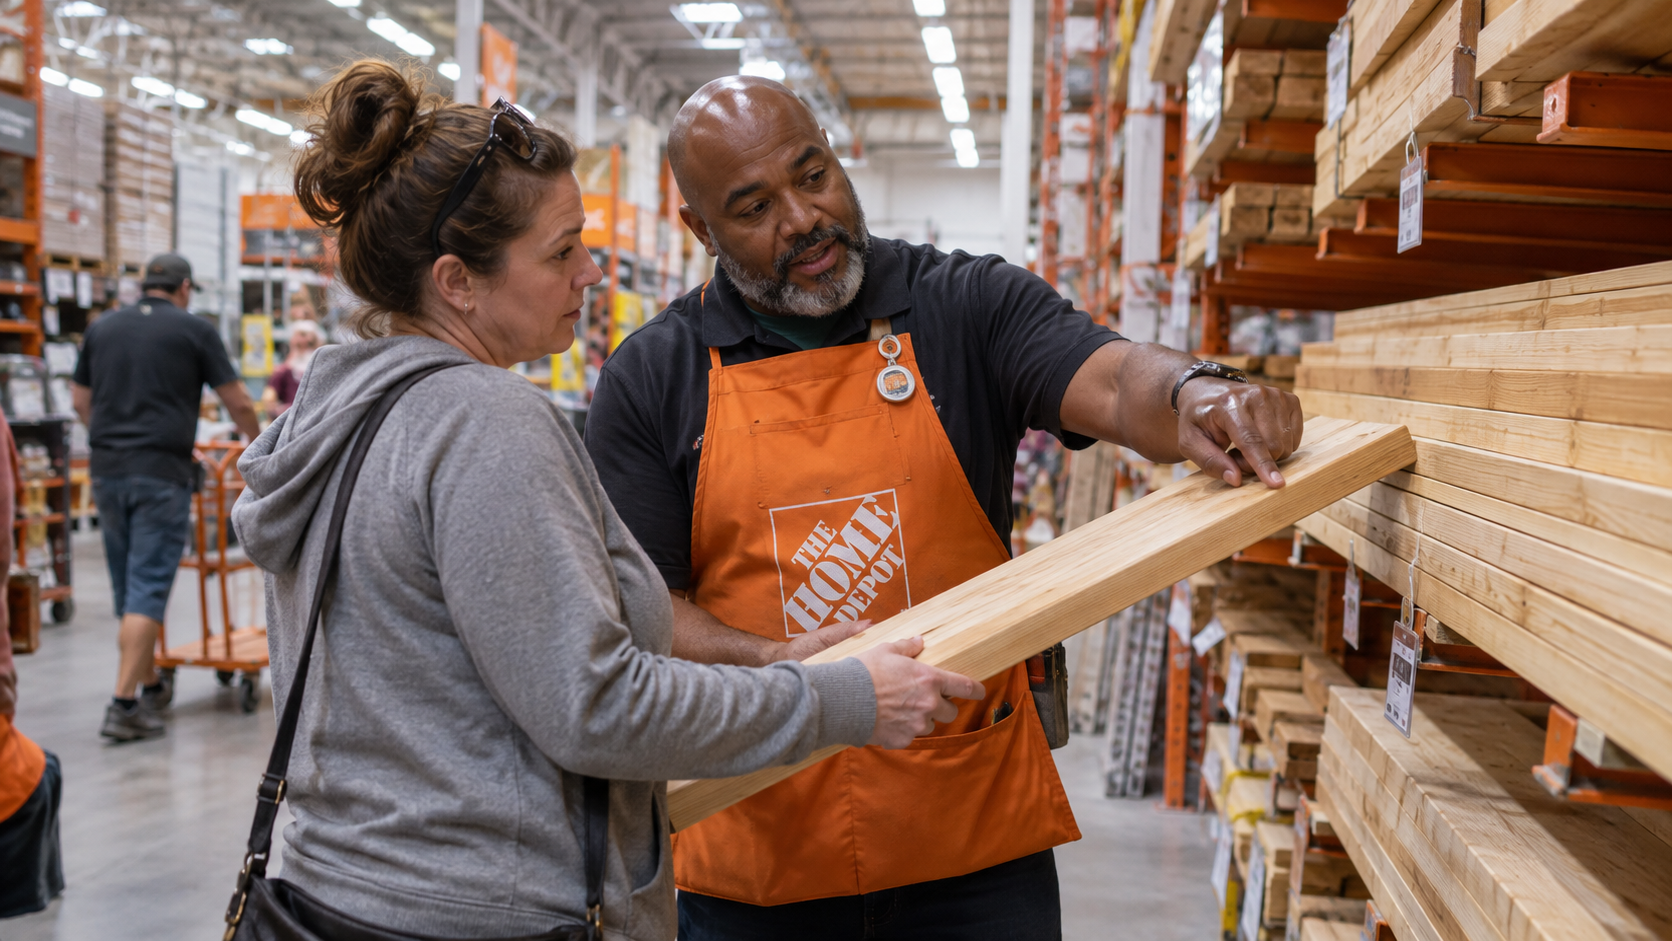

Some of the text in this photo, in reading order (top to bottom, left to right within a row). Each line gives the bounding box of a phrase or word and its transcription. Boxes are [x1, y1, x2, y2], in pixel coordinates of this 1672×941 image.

[784, 495, 899, 632] HOME
[791, 519, 838, 570] THE
[833, 543, 904, 623] DEPOT
